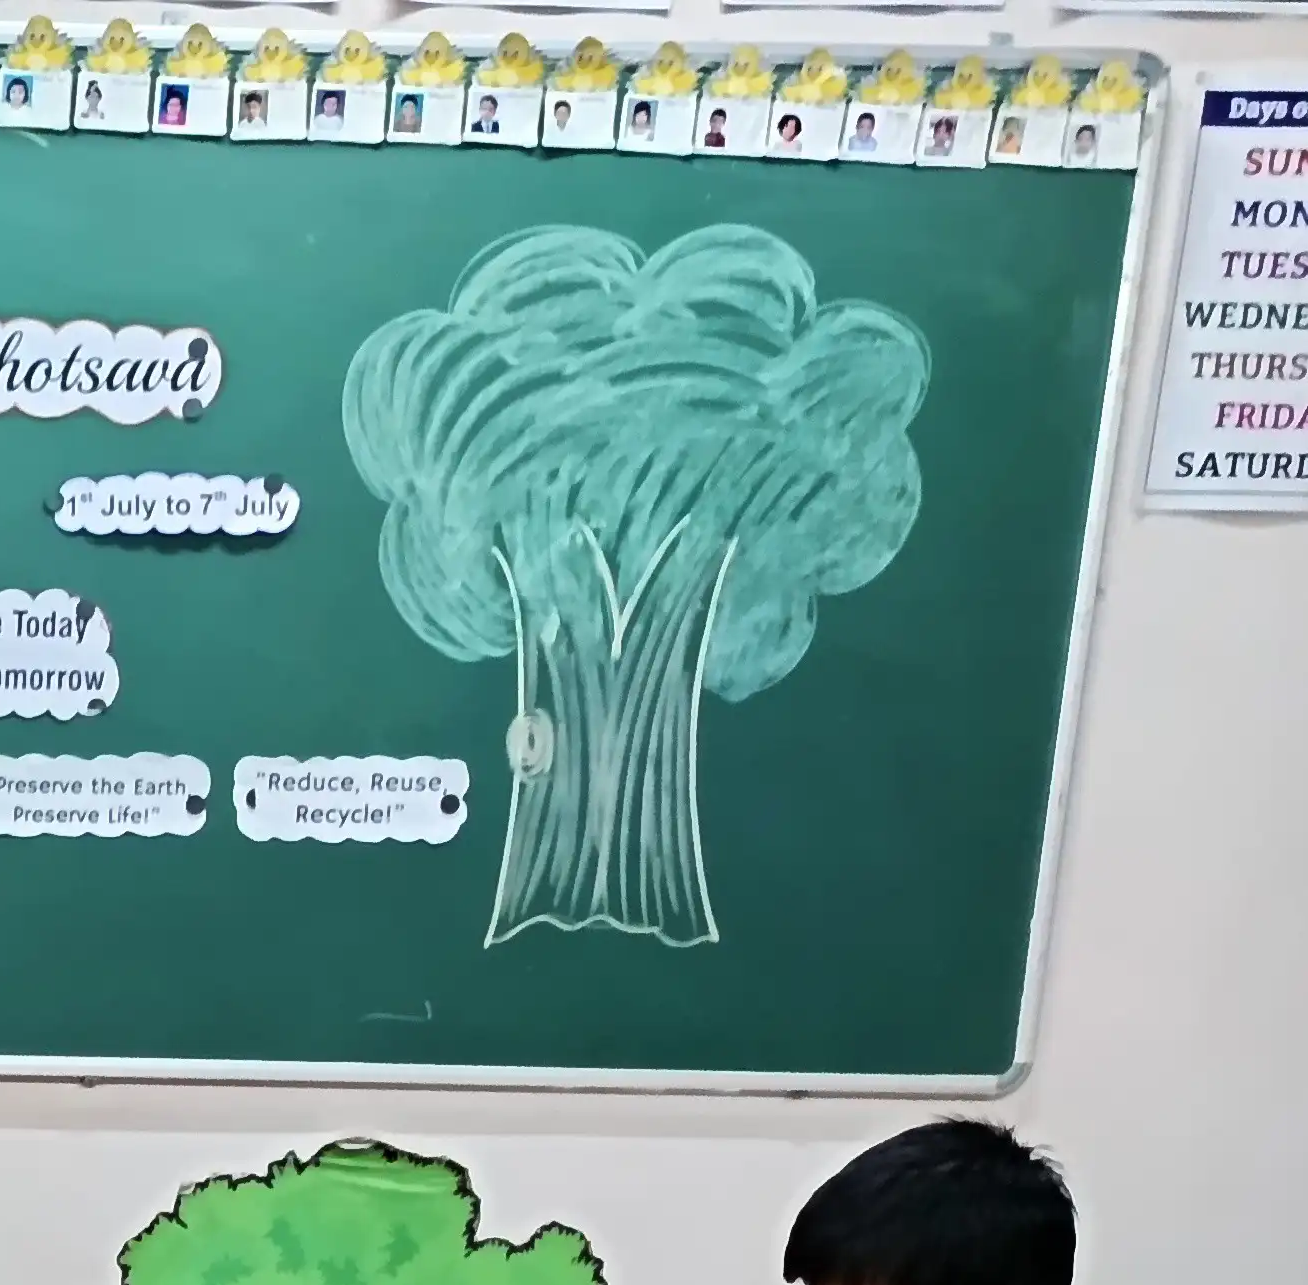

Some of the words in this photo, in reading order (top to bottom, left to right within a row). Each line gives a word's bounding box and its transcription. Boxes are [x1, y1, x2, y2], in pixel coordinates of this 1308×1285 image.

[1229, 97, 1288, 125] Days
[1221, 250, 1308, 279] TUES
[1185, 301, 1308, 330] WEDNE
[1191, 352, 1308, 380] THURS
[101, 495, 155, 521] July
[166, 496, 190, 516] to
[235, 495, 289, 521] July
[13, 609, 90, 644] Today
[91, 777, 126, 795] the
[370, 773, 449, 795] Reuse,
[13, 805, 99, 824] Preserve
